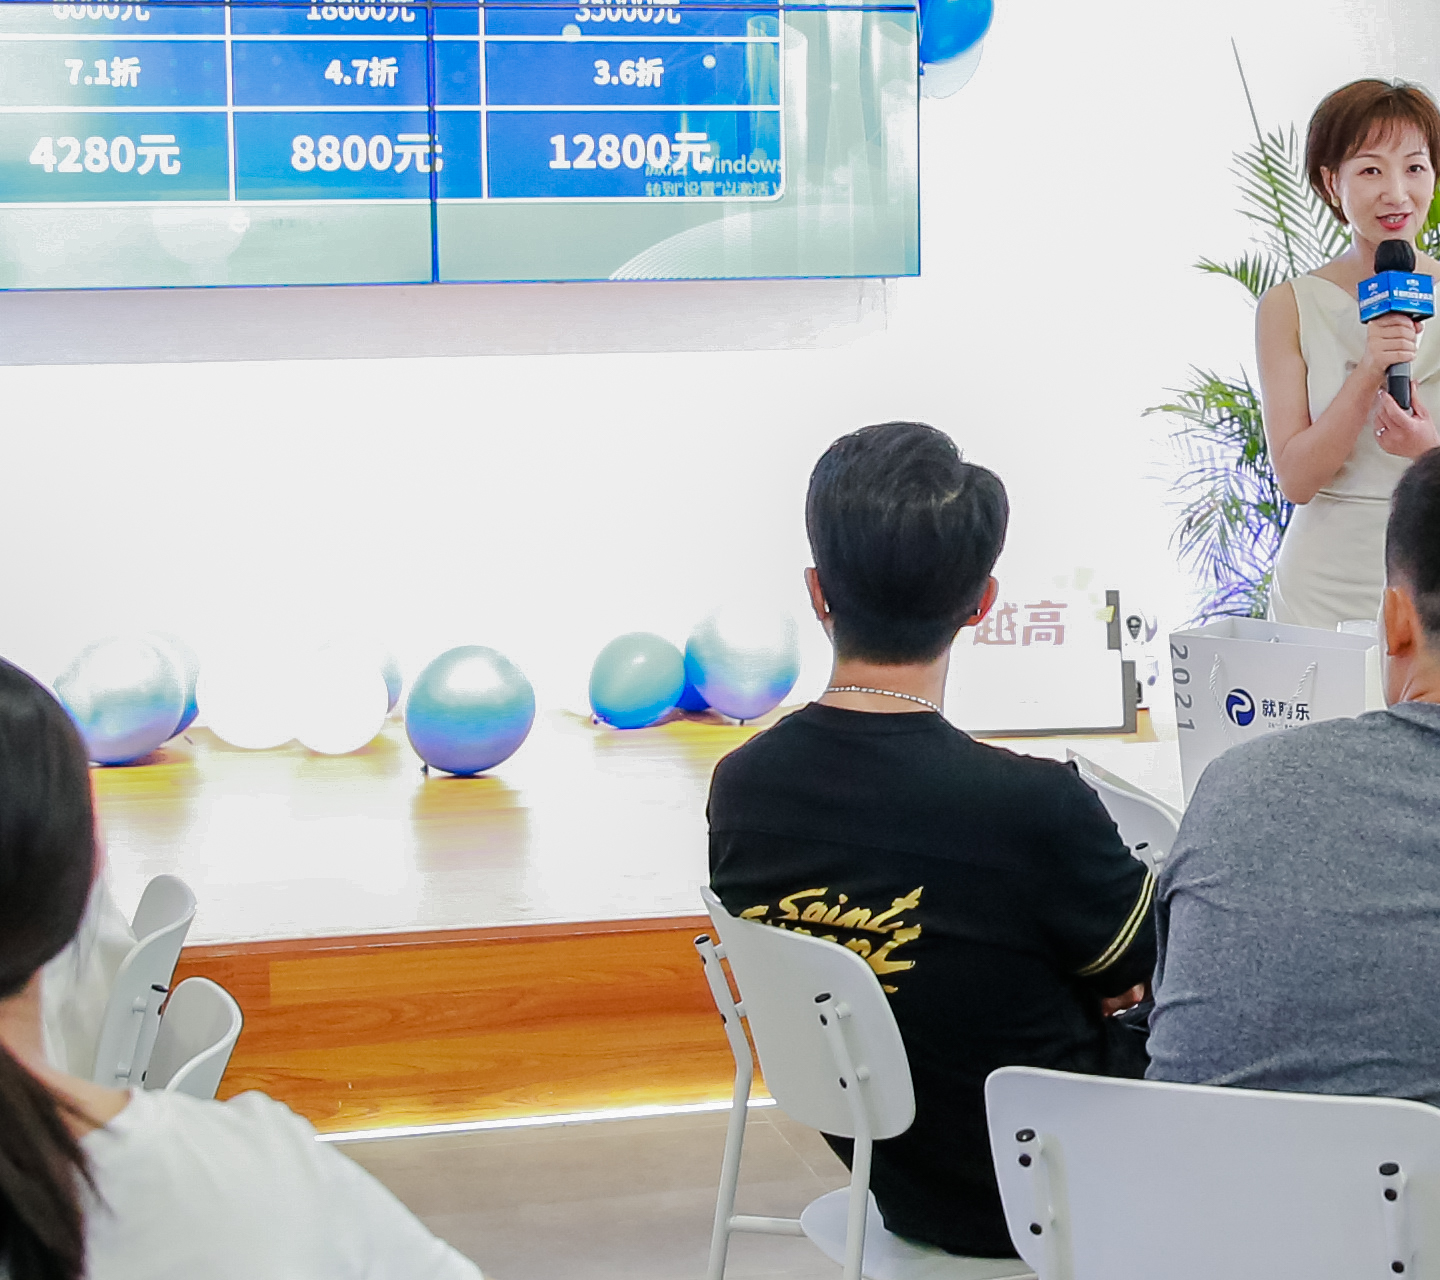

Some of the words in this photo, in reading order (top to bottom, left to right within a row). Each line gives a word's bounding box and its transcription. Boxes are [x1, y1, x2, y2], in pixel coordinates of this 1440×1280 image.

[64, 57, 141, 88] 7.1折
[324, 56, 399, 88] 4.7折
[593, 57, 664, 89] 3.6折
[29, 134, 181, 176] 4280元
[291, 133, 443, 174] 8800元
[549, 131, 711, 172] 12800元
[1170, 642, 1196, 730] 2021
